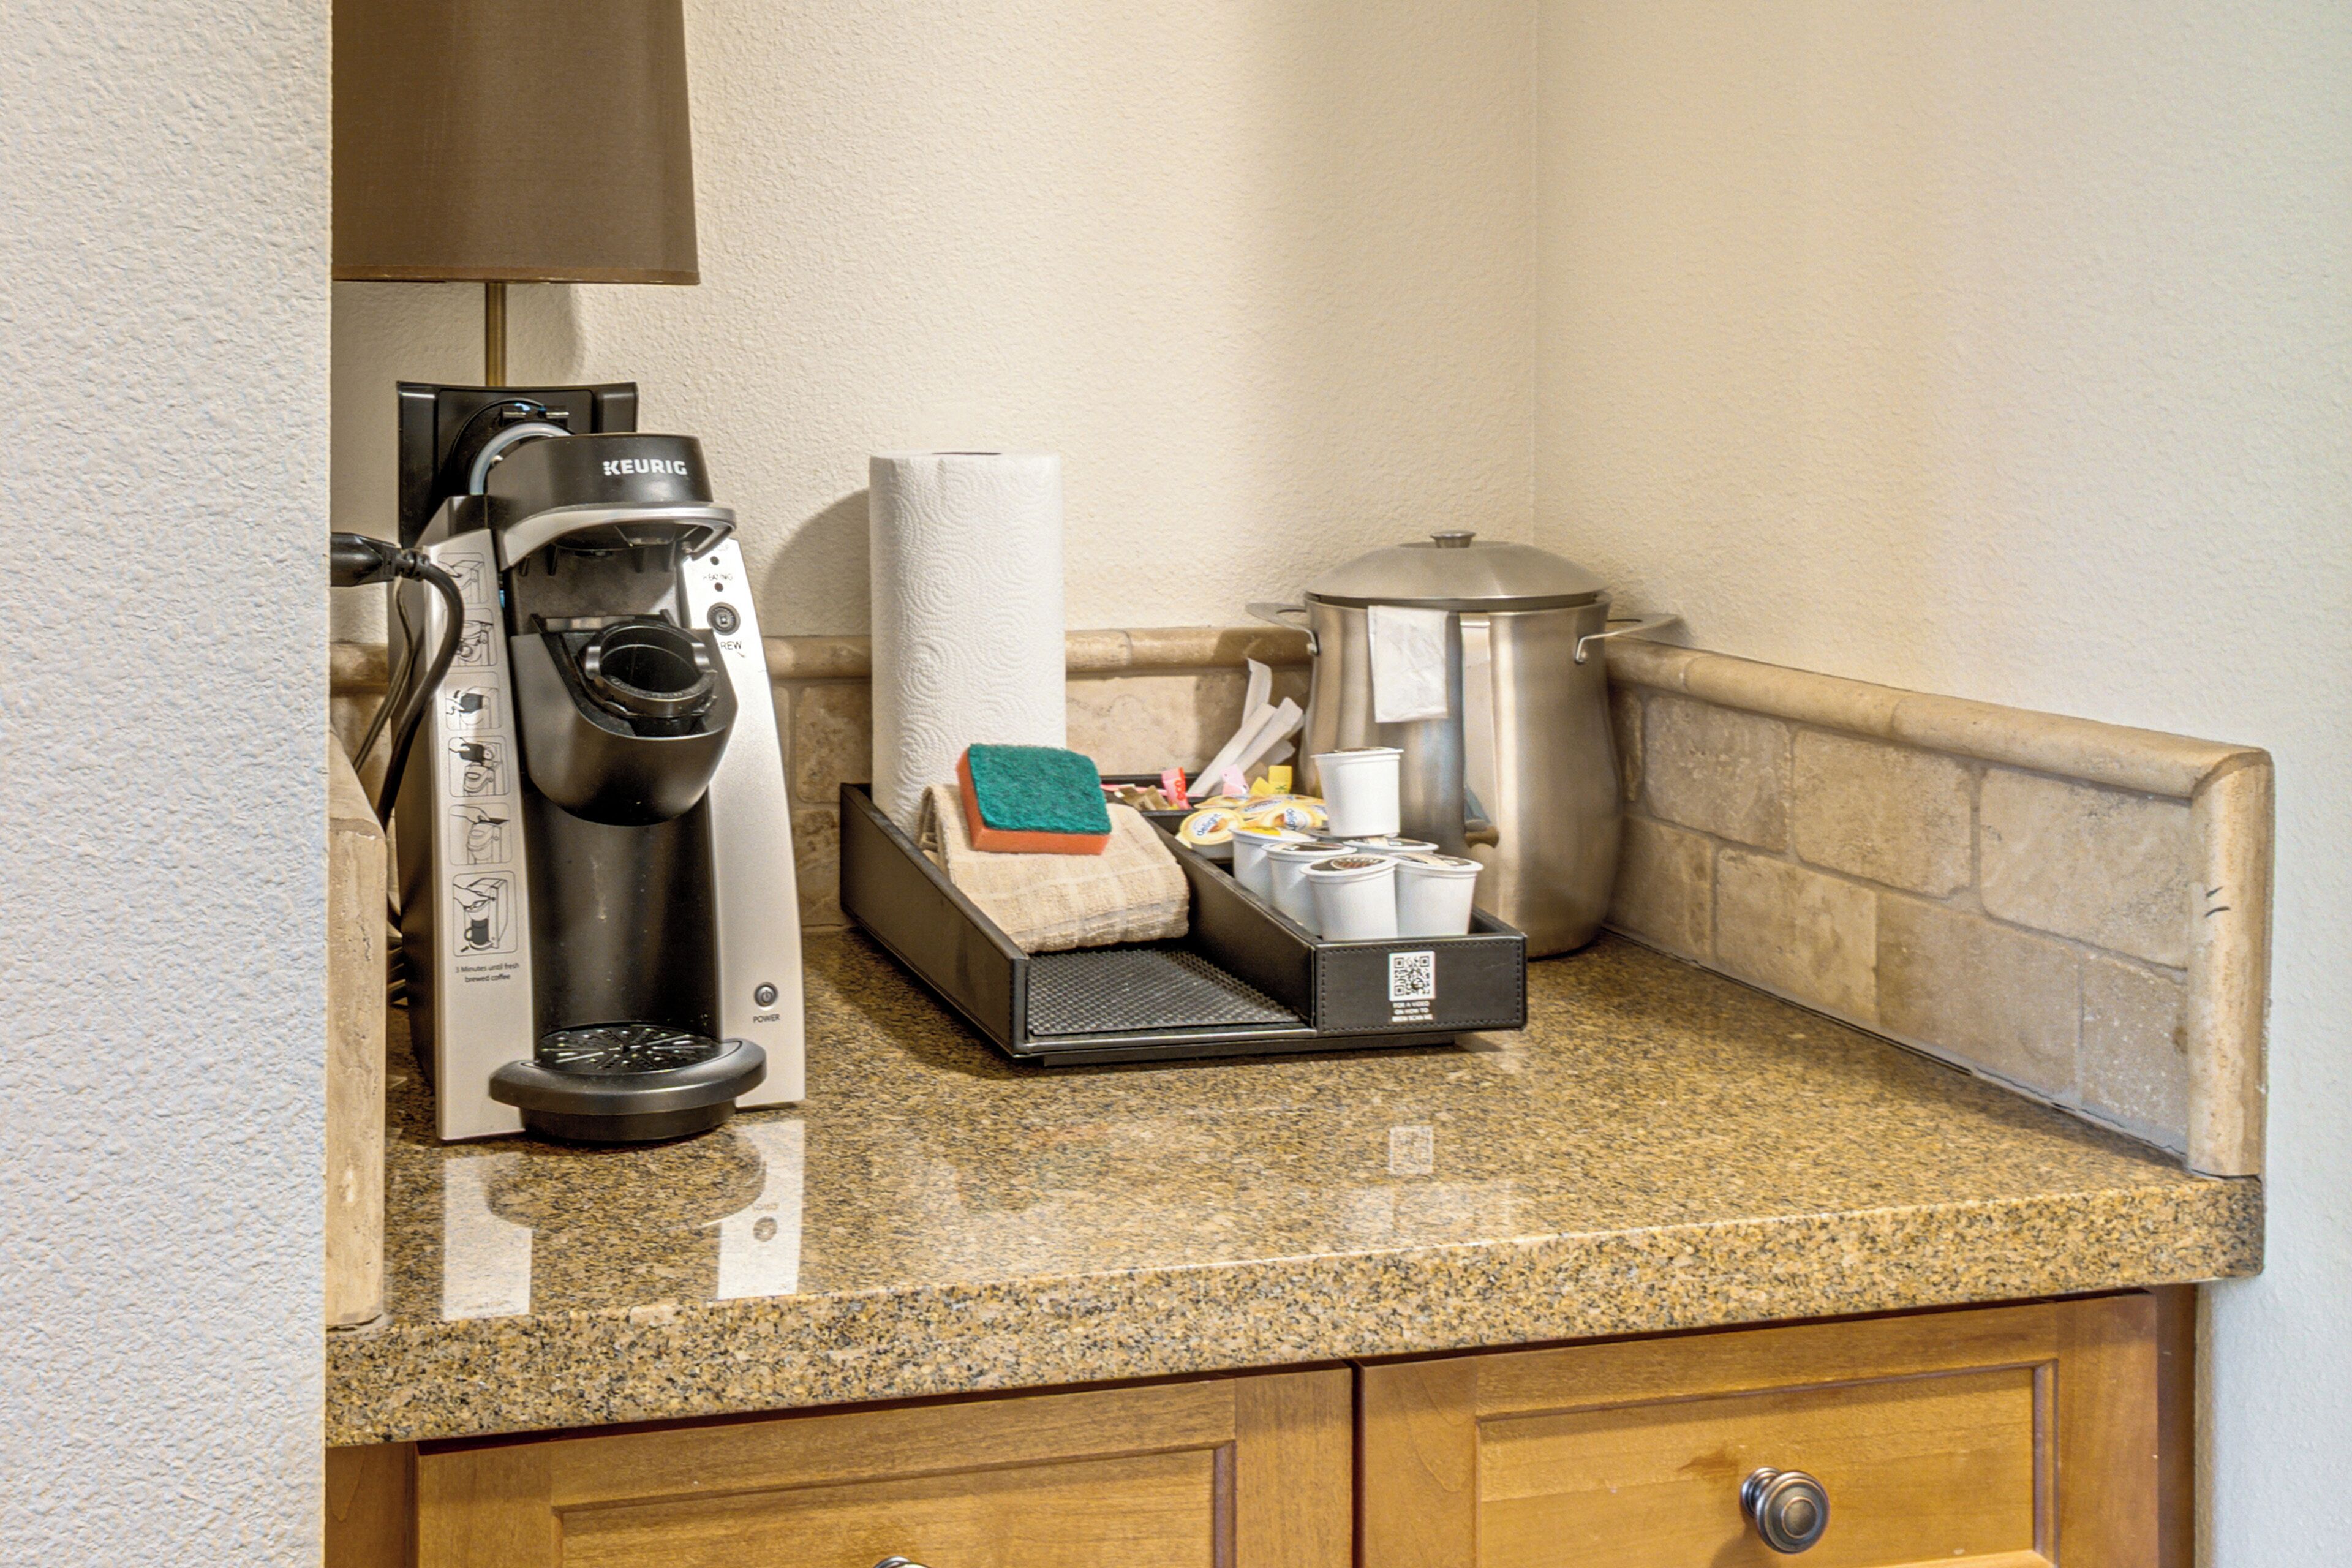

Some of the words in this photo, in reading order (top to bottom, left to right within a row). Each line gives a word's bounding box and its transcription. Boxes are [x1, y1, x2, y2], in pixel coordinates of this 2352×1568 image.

[603, 459, 688, 476] KEURIG
[720, 640, 742, 650] REW
[753, 1013, 780, 1023] POWER
